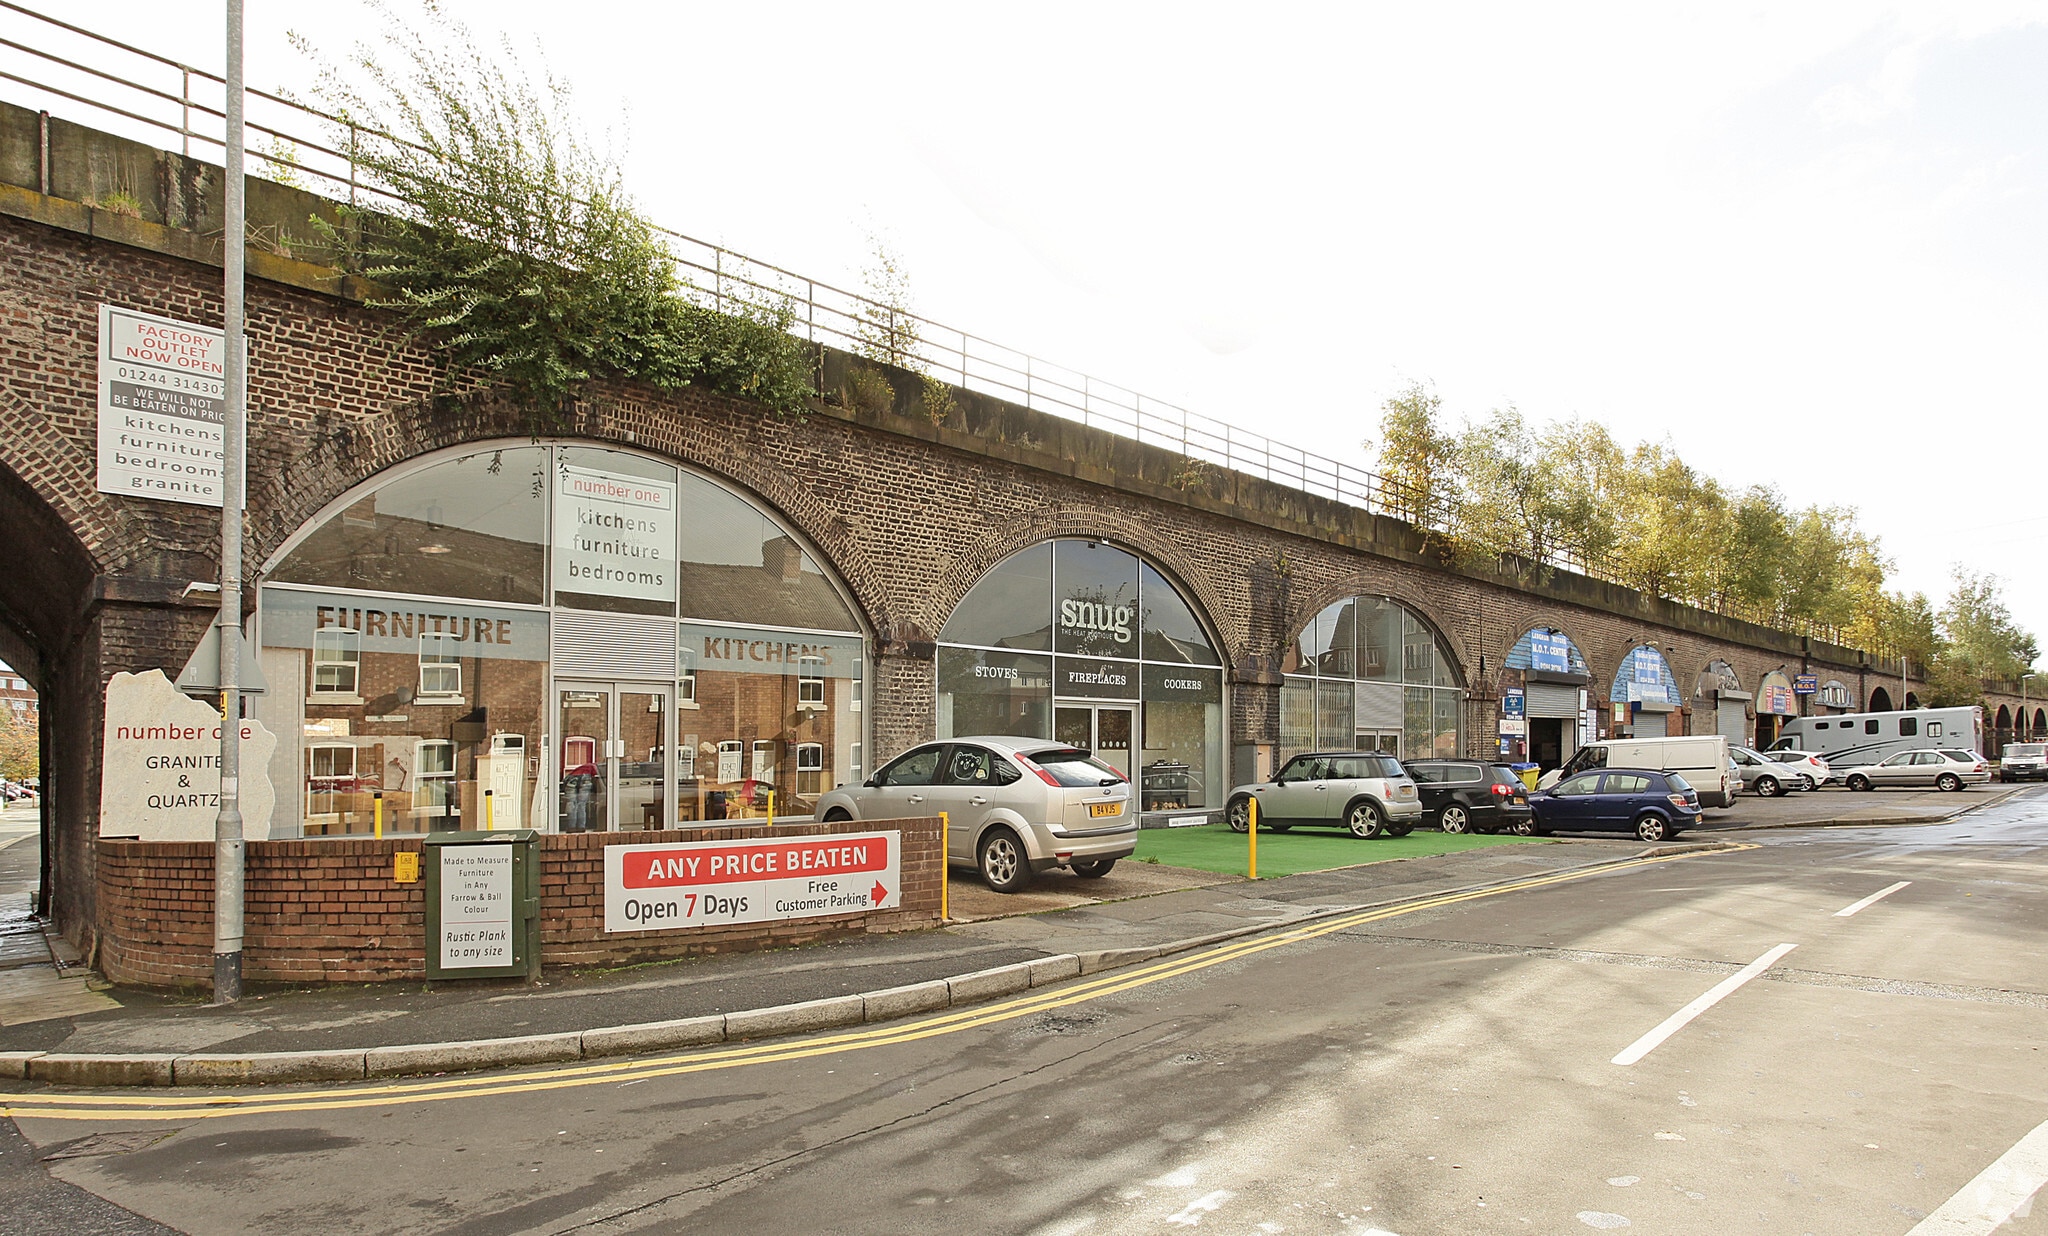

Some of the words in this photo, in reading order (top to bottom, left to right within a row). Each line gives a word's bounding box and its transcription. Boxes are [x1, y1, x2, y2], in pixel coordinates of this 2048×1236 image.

[137, 323, 213, 348] FACTORY
[143, 337, 208, 359] OUTLET
[126, 346, 172, 364] NOW
[177, 356, 223, 374] OPEN
[118, 367, 167, 385] 01244
[136, 387, 154, 400] WE
[158, 391, 185, 405] WILL
[189, 397, 213, 409] NOT
[114, 395, 129, 406] BE
[133, 398, 177, 413] BEATEN
[180, 405, 197, 417] ON
[201, 410, 225, 422] PRIC
[125, 415, 221, 441] kitchens
[119, 434, 224, 460] furniture
[131, 476, 213, 496] granite
[574, 478, 631, 498] number
[634, 489, 661, 503] one
[577, 507, 657, 533] kitchens
[573, 534, 660, 560] furniture
[569, 560, 664, 586] bedrooms
[316, 605, 512, 645] FURNITURE
[1061, 599, 1134, 644] snug
[1061, 628, 1071, 636] THE
[1073, 629, 1086, 637] HEAT
[704, 636, 833, 666] KITCHENS
[1532, 643, 1550, 655] M.O.T.
[975, 666, 1018, 679] STOVES
[1069, 671, 1127, 685] FIREPLACES
[1164, 679, 1202, 690] COOKERS
[117, 723, 205, 740] number
[212, 726, 252, 740] oe
[146, 755, 222, 769] GRANITE
[177, 774, 191, 788] &
[147, 793, 219, 810] QUARTZ
[444, 857, 465, 866] Made
[467, 857, 475, 865] to
[477, 857, 509, 865] Measure
[647, 857, 702, 880] ANY
[710, 852, 777, 876] PRICE
[786, 845, 867, 871] BEATEN
[459, 869, 494, 877] Furniture
[464, 881, 472, 889] in
[474, 881, 489, 890] Any
[808, 880, 838, 893] Free
[451, 894, 477, 902] Farrow
[480, 893, 485, 901] &
[488, 892, 502, 901] Ball
[775, 897, 828, 913] Customer
[830, 892, 868, 908] Parking
[464, 906, 489, 914] Colour
[624, 898, 678, 925] Open
[684, 893, 697, 918] 7
[704, 894, 749, 917] Days
[446, 931, 476, 942] Rustic
[478, 929, 506, 941] Plank
[450, 948, 460, 958] to
[463, 948, 481, 959] any
[484, 945, 503, 957] size
